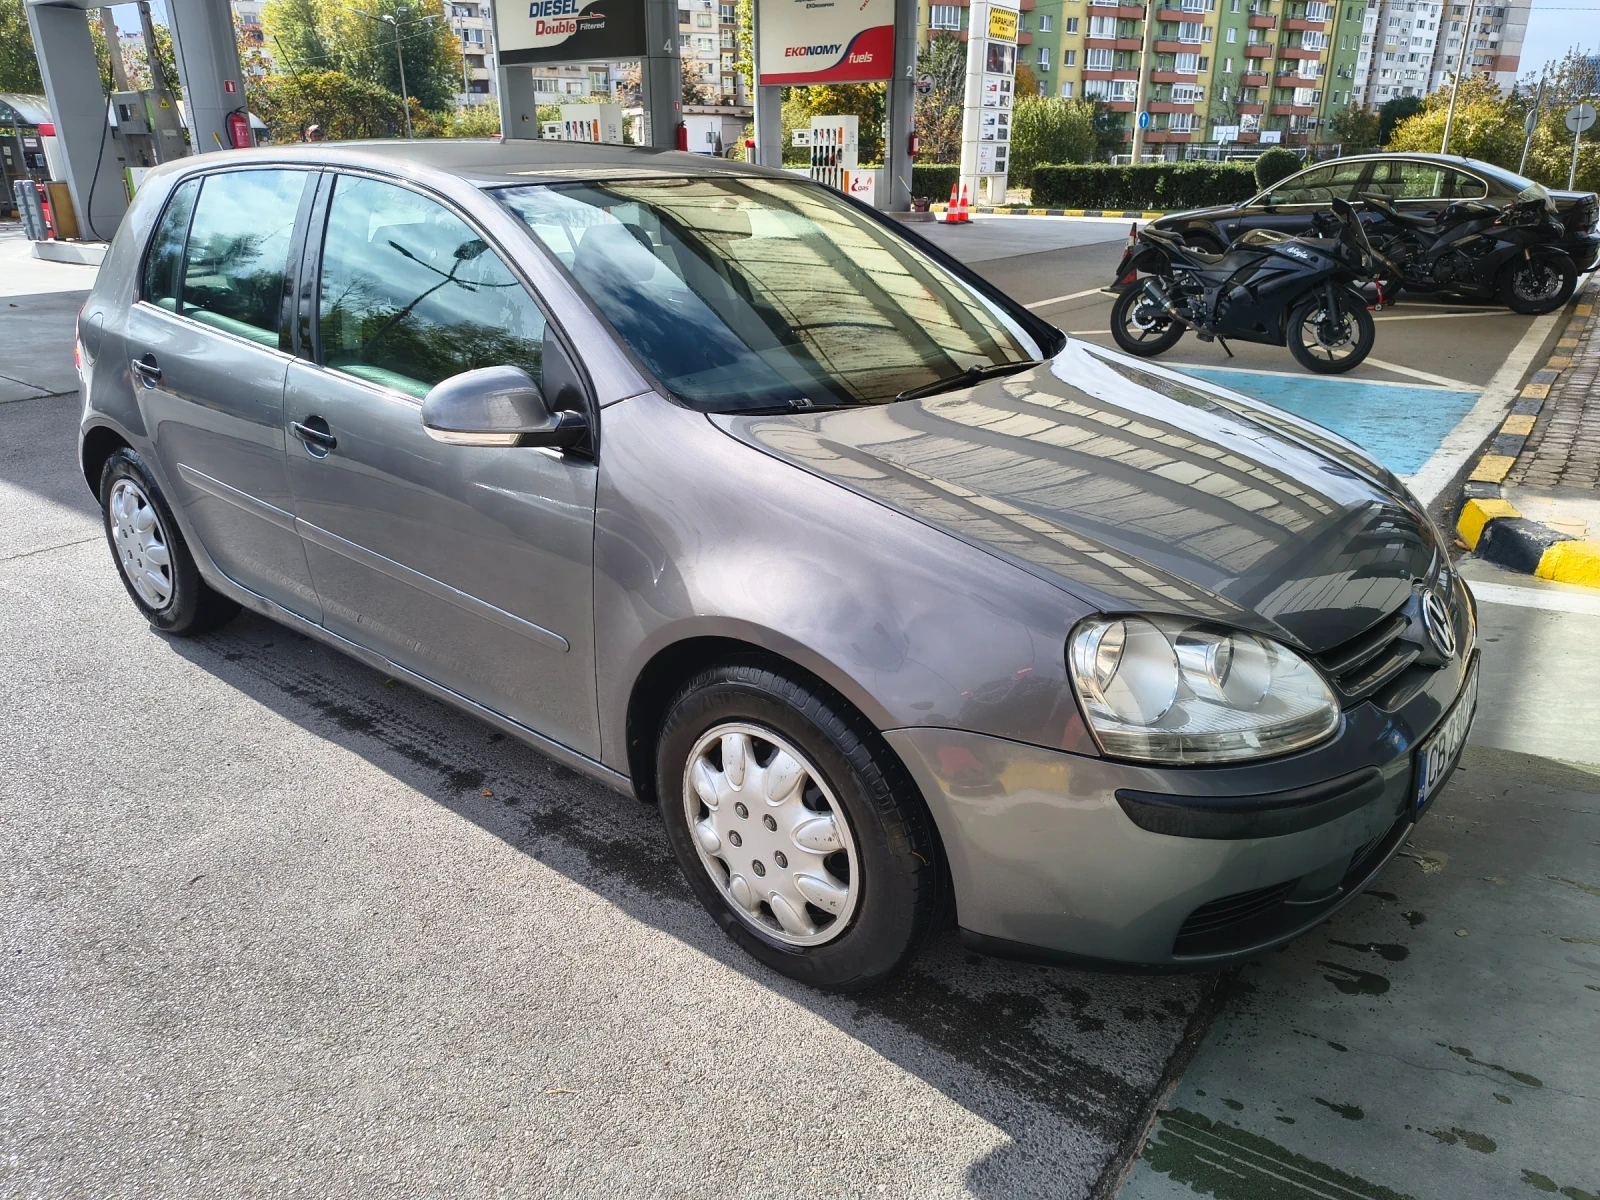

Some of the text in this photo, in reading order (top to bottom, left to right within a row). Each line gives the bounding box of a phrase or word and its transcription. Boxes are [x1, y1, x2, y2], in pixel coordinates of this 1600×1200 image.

[529, 0, 579, 18] DIESEL
[536, 20, 605, 35] Double Filtered
[663, 38, 673, 54] 4
[785, 44, 842, 57] EKONOMY
[849, 52, 873, 64] fuels
[906, 65, 913, 77] 2
